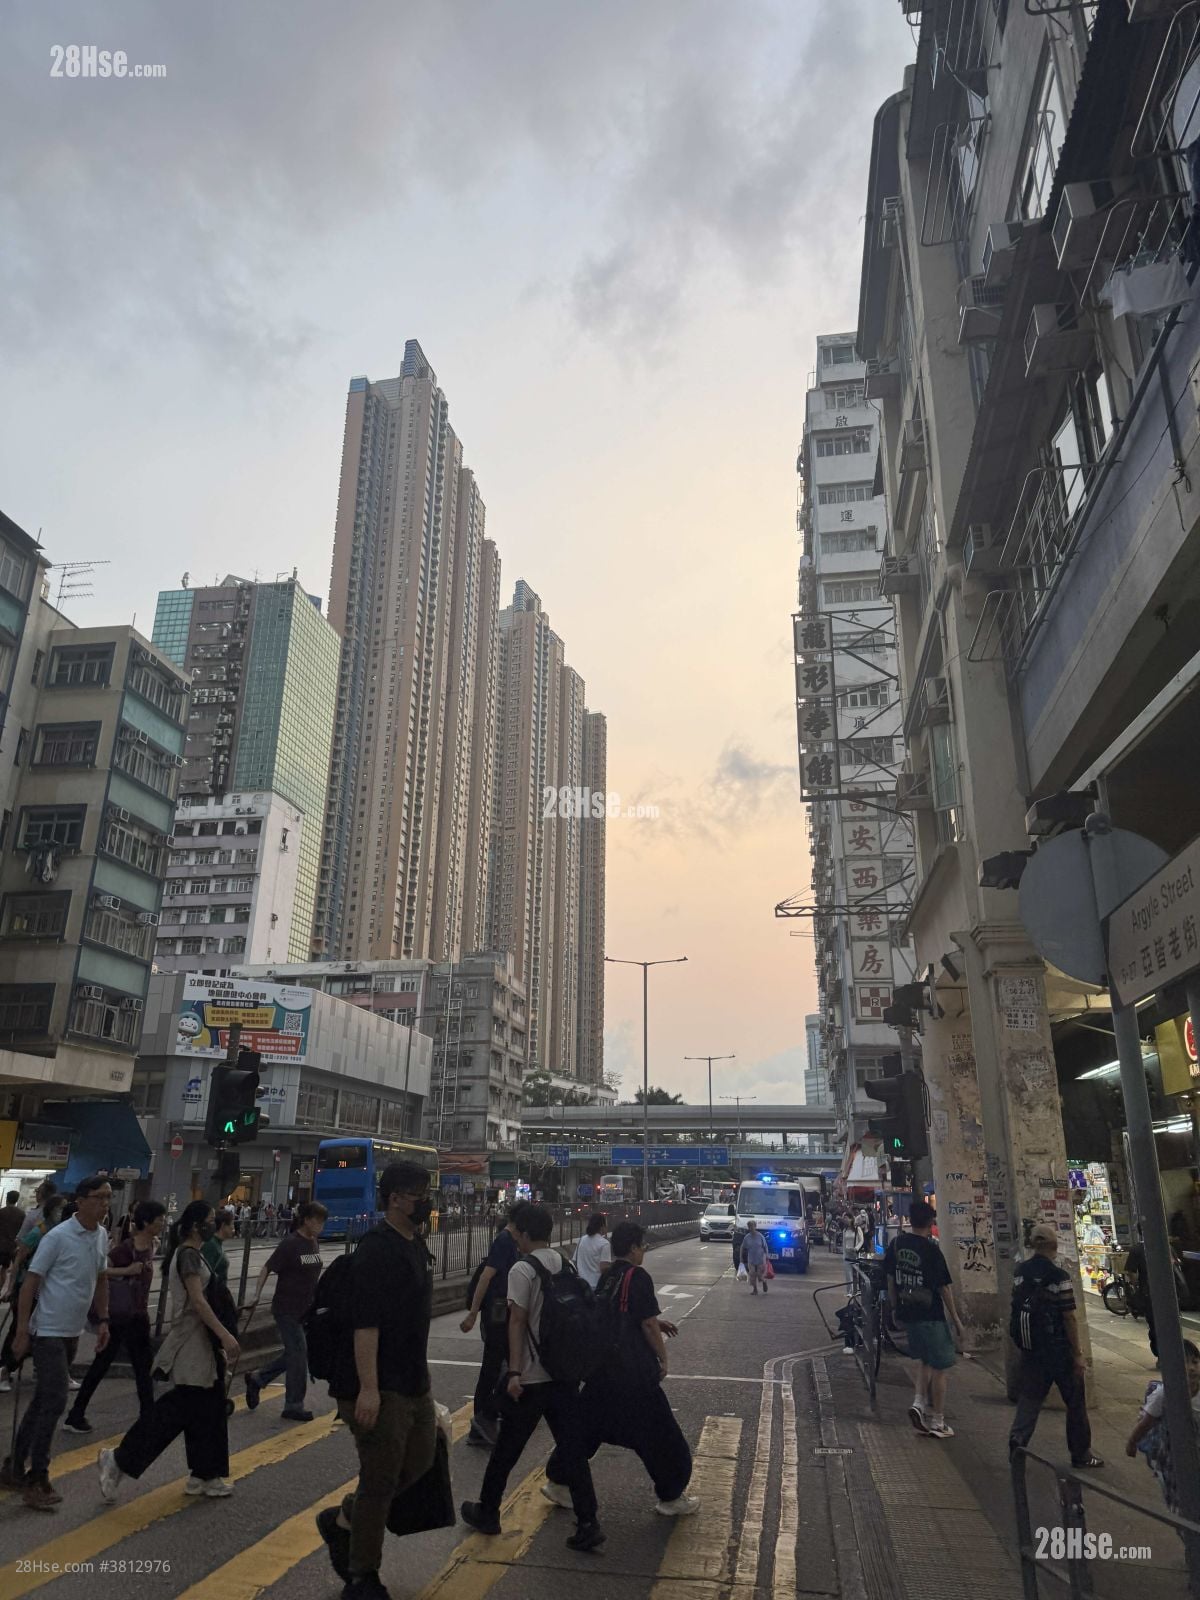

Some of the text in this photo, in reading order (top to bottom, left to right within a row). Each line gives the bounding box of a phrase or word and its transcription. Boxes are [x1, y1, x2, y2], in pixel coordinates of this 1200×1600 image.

[1131, 865, 1195, 932] Argyle Street
[1140, 914, 1198, 978] 亞皆老街
